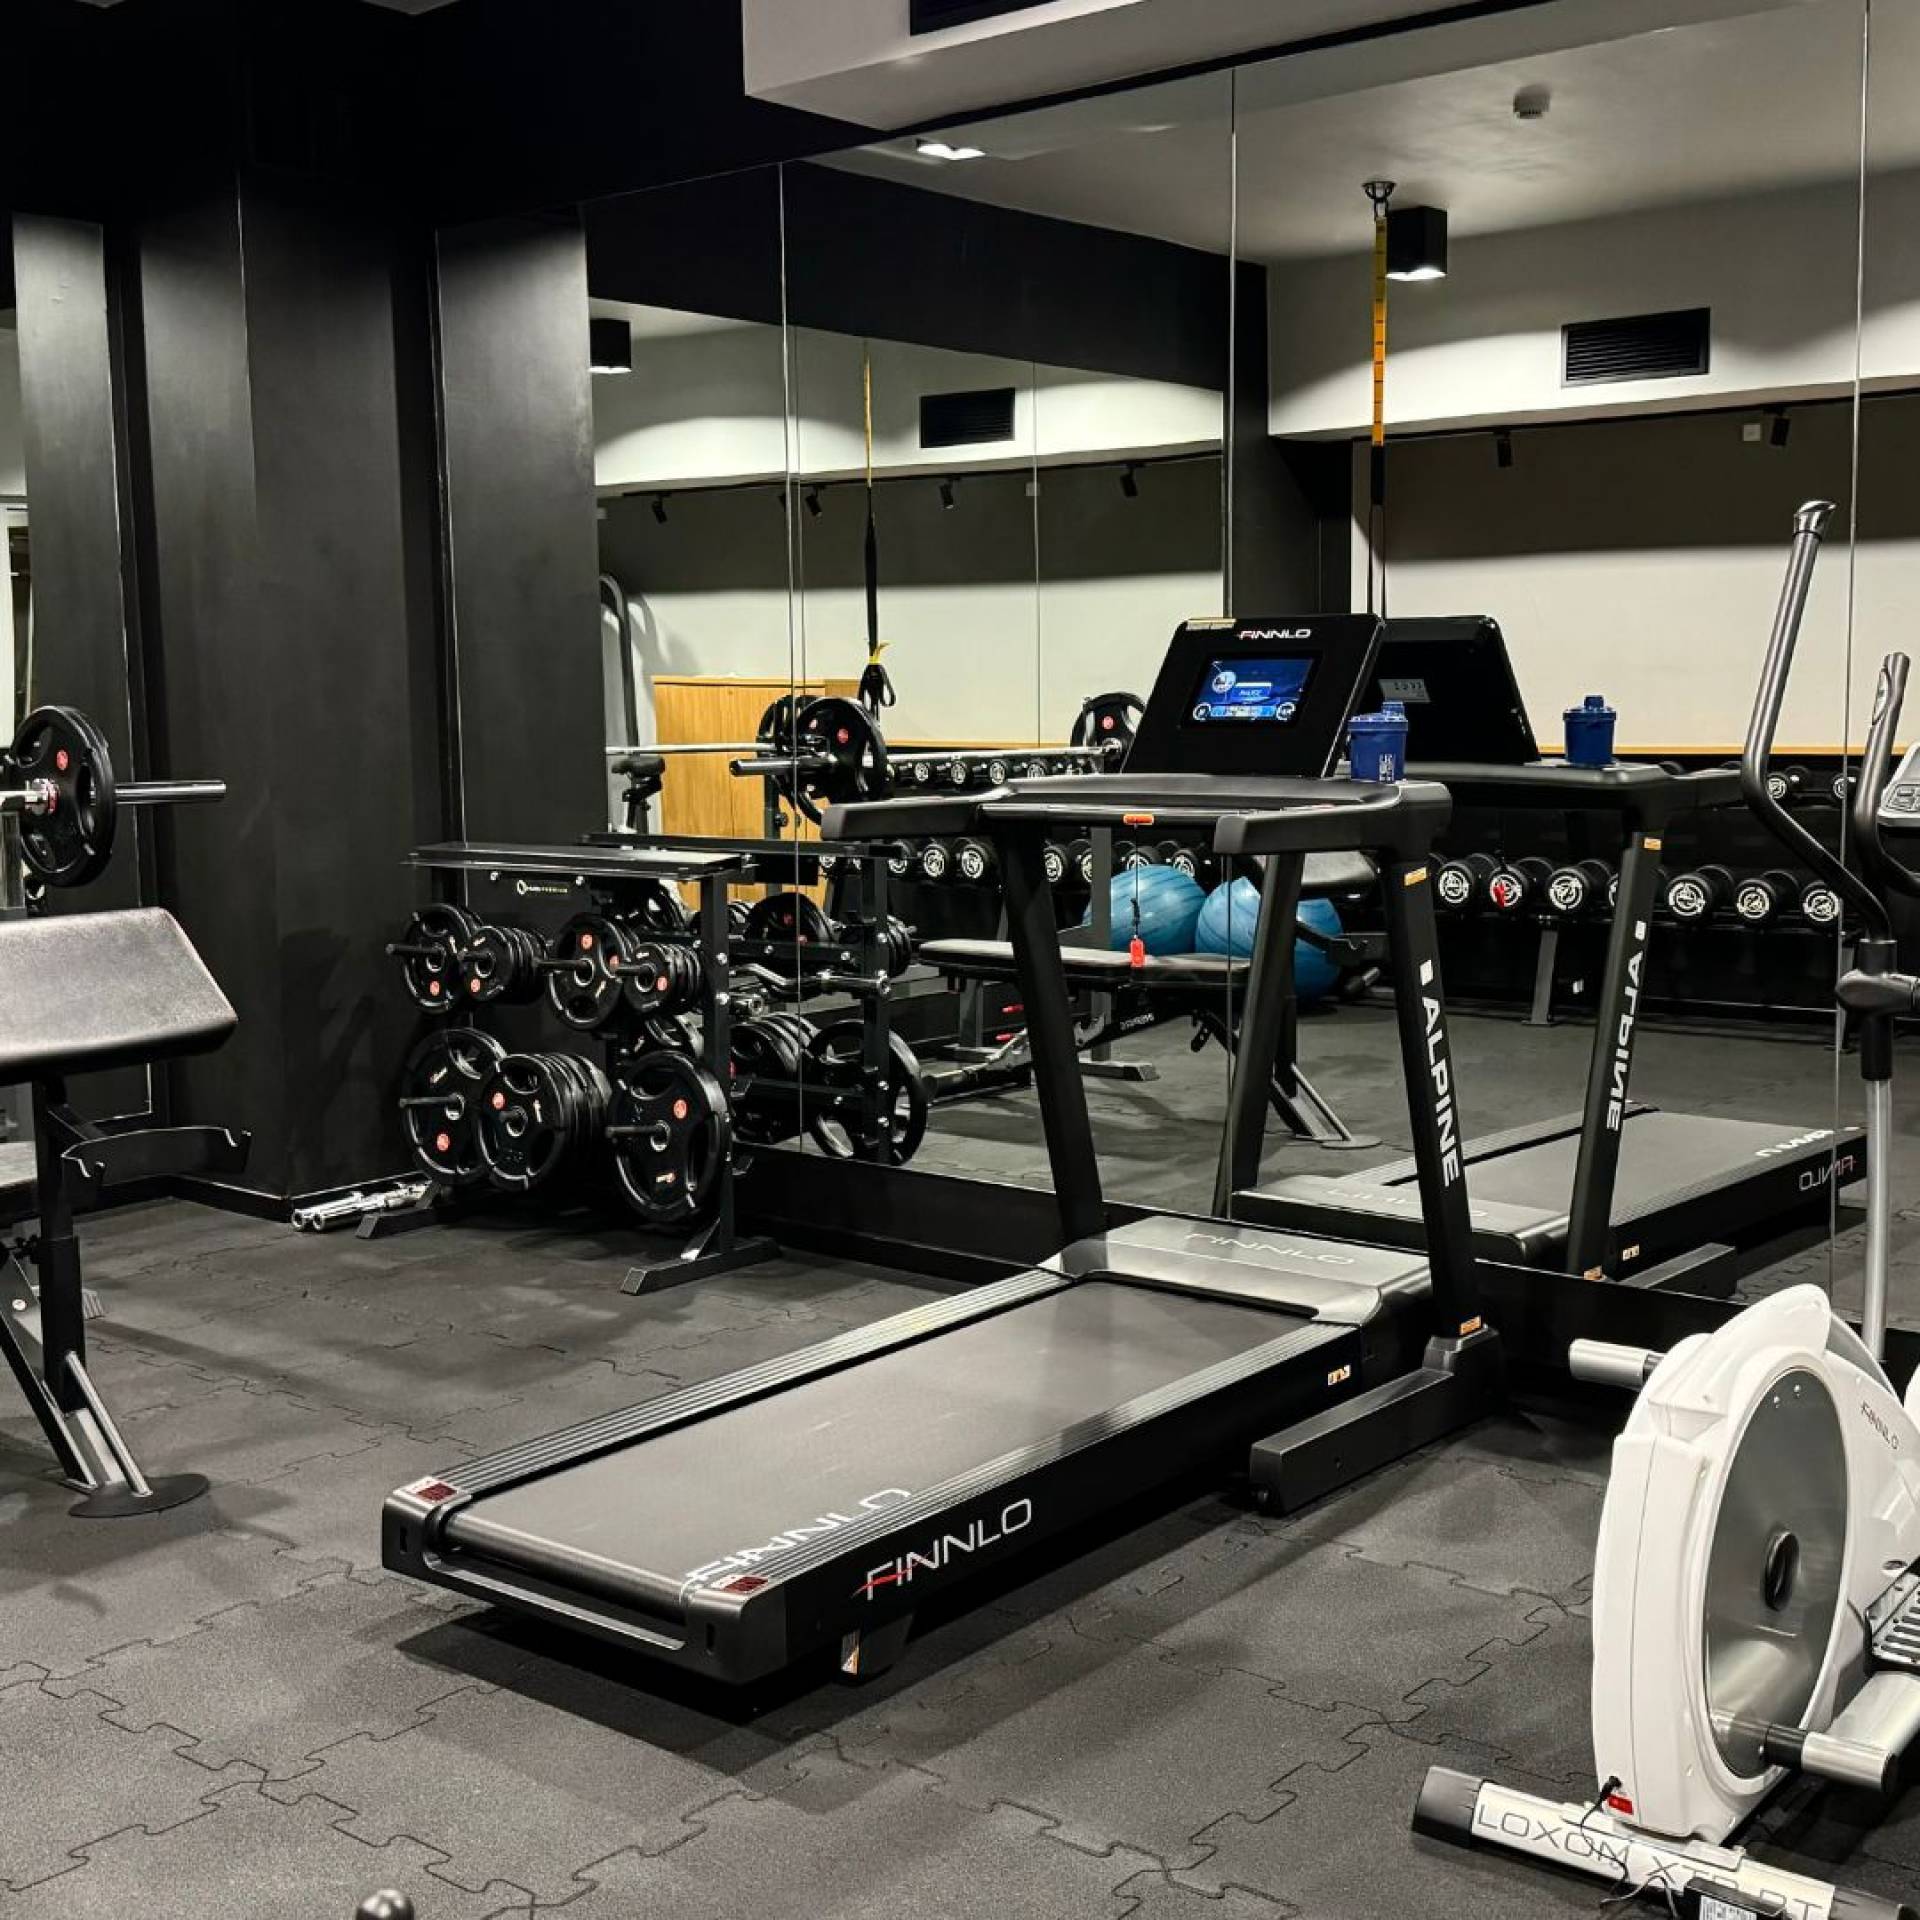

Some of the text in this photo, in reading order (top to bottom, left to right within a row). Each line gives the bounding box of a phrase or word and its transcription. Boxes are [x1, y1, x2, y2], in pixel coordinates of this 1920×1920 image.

[1237, 628, 1312, 640] FINNLO
[1421, 996, 1461, 1187] ALPINE
[852, 1498, 1032, 1600] FINNLO
